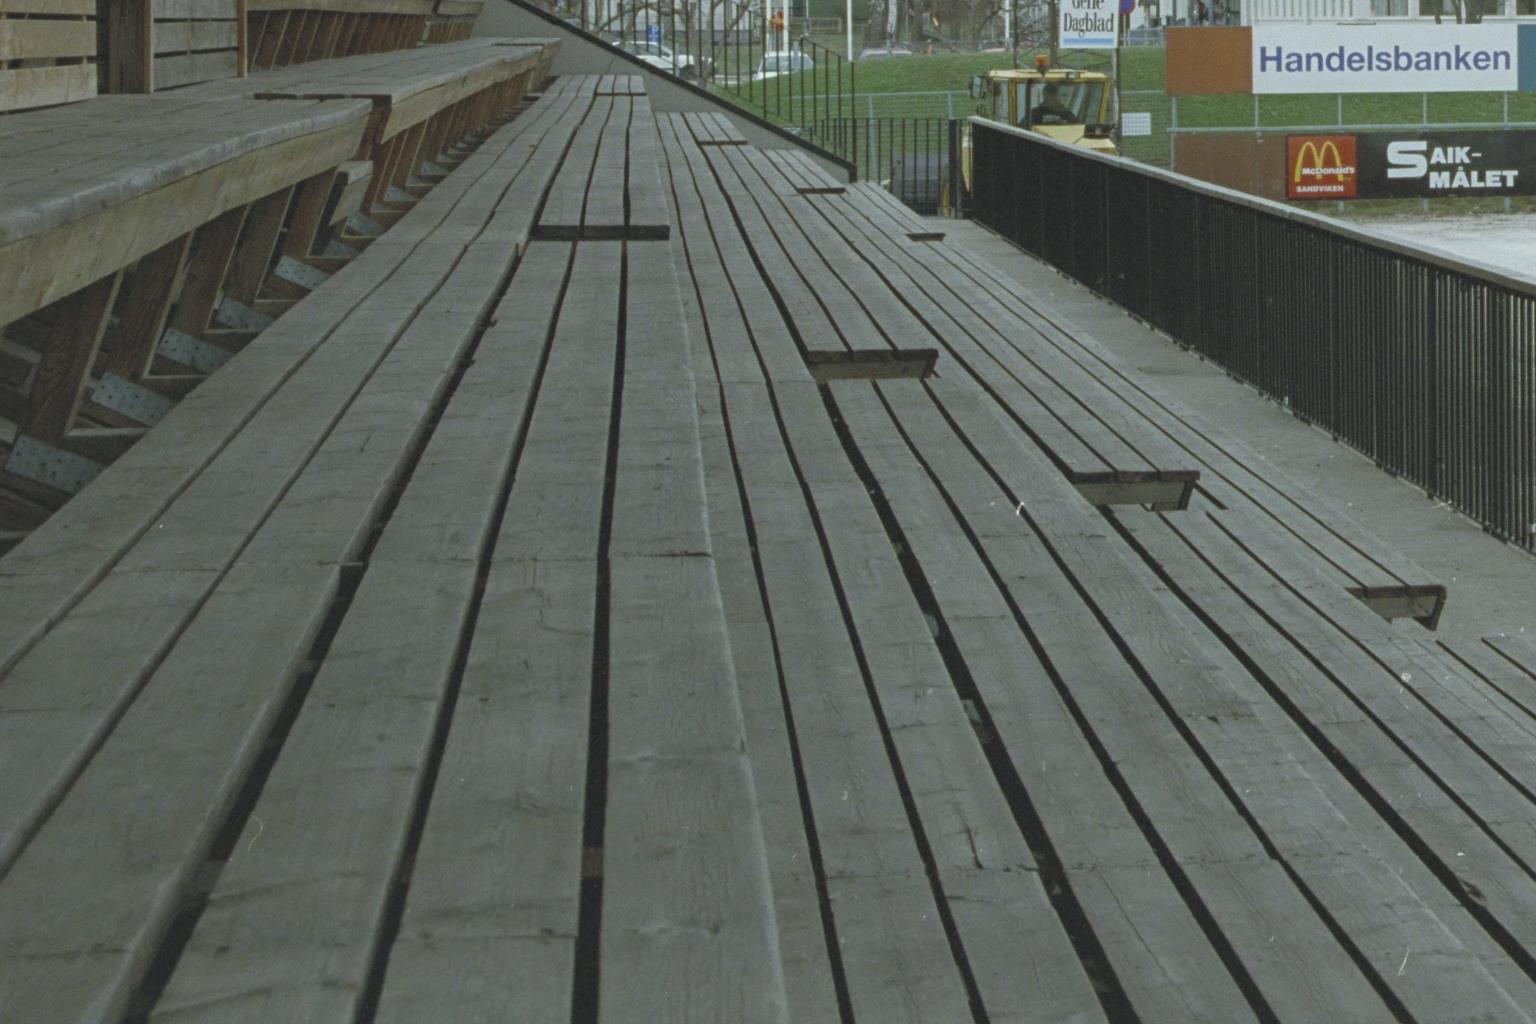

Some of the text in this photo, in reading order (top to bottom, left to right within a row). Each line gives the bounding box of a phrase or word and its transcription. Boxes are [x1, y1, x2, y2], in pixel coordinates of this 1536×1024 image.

[1063, 13, 1114, 38] Dagblad
[1259, 44, 1511, 73] Handelsbanken
[1302, 166, 1355, 175] McDonald's
[1429, 167, 1519, 189] MÅLET
[1296, 184, 1344, 193] SANDVIKEN
